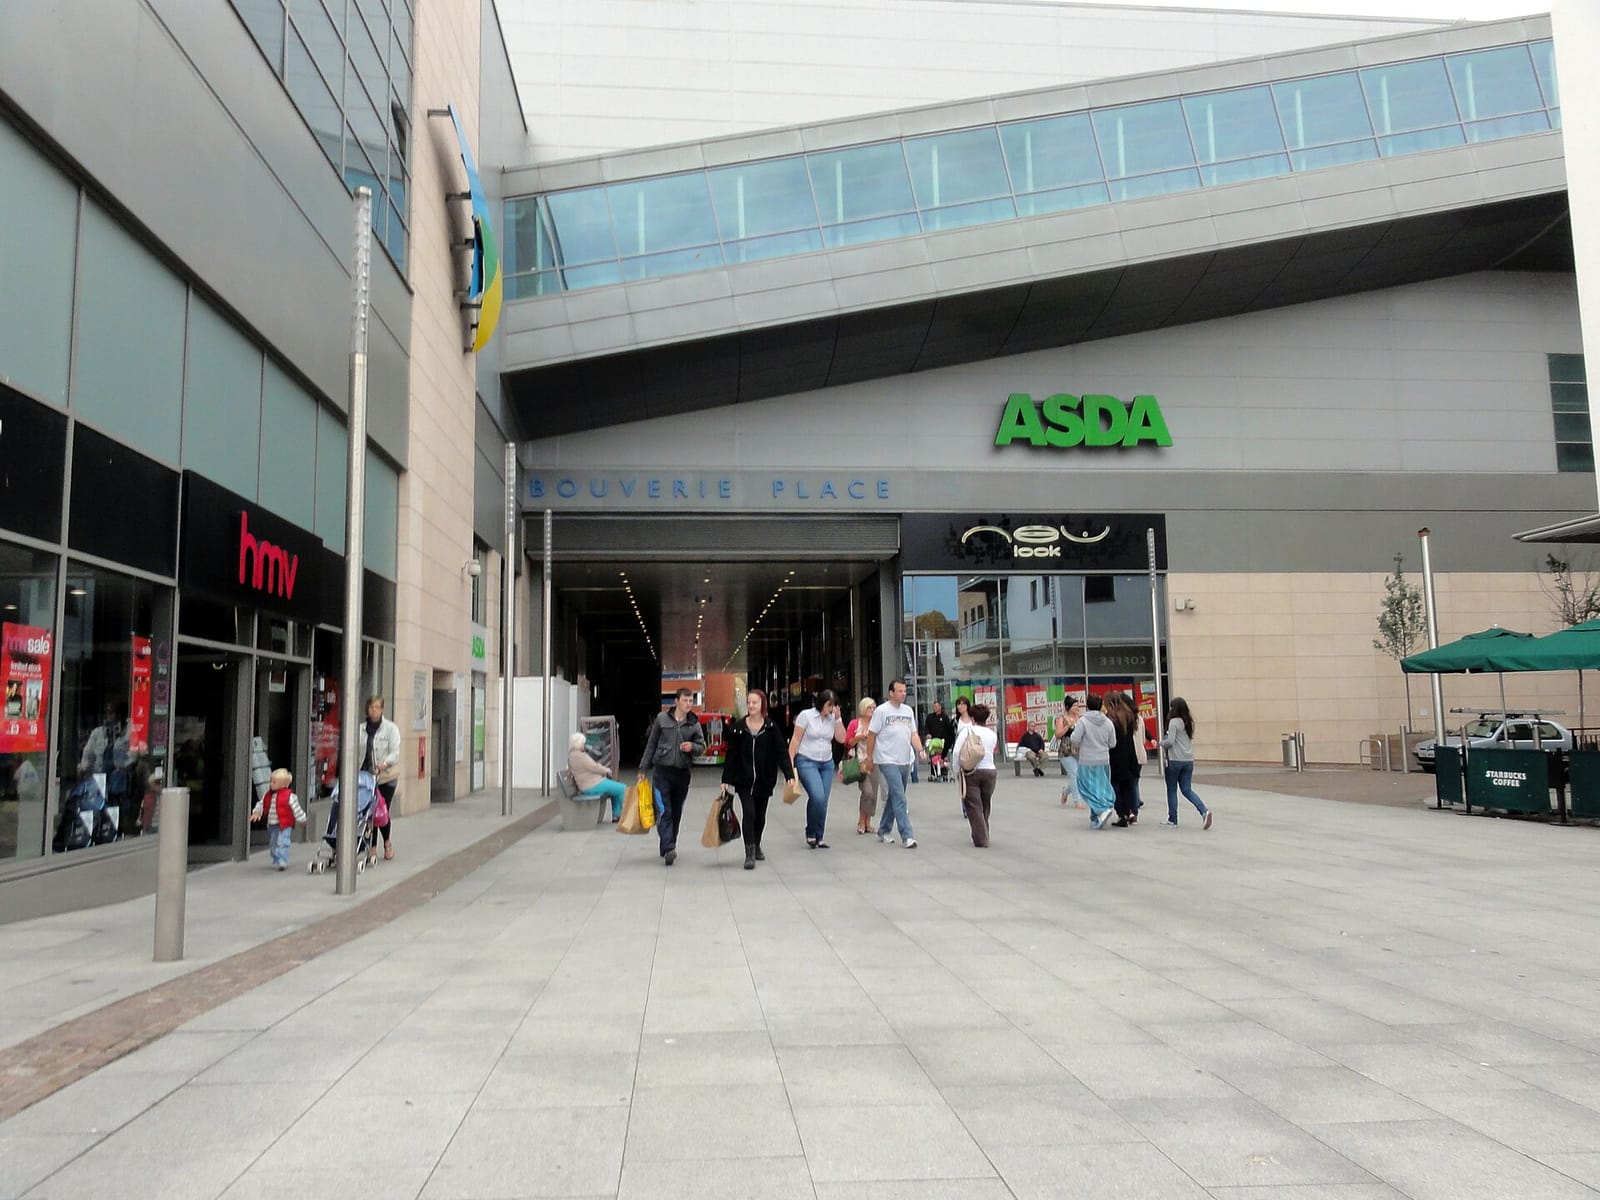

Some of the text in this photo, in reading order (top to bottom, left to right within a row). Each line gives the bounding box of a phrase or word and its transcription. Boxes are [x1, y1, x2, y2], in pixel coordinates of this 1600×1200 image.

[995, 393, 1173, 447] ASDA
[529, 479, 890, 499] BOUVERIE PLACE
[961, 525, 1111, 544] new
[239, 511, 298, 600] hmv
[1013, 545, 1062, 557] look
[27, 635, 50, 655] sale
[1485, 770, 1527, 780] STARBUCKS
[1492, 779, 1521, 787] COFFEE
